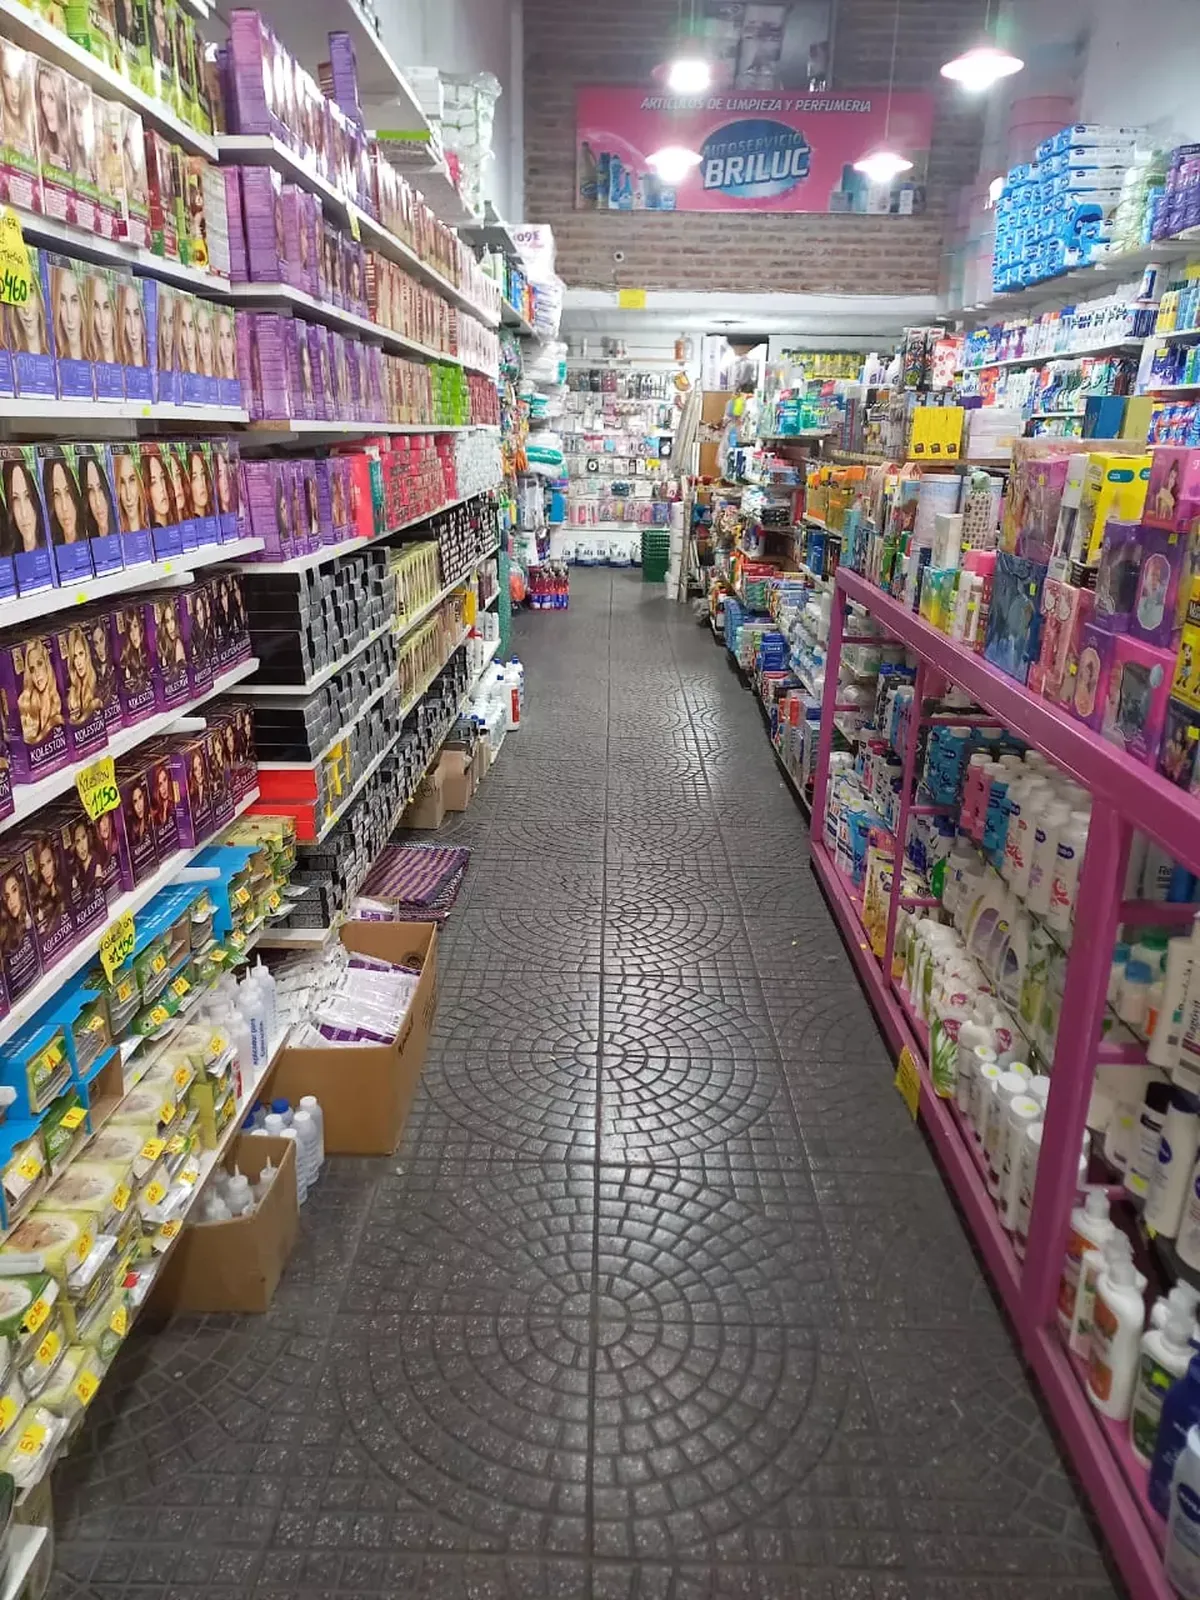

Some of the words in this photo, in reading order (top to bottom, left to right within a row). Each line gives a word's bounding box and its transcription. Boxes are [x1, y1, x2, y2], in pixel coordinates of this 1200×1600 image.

[707, 98, 724, 110] DE
[726, 99, 782, 111] LIMPIEZA
[784, 99, 793, 111] Y
[795, 99, 872, 112] PERFUMERIA
[703, 133, 802, 156] AUTOSERVICIO
[704, 147, 810, 189] BRILUC
[74, 719, 105, 742] KOLESTON
[30, 736, 66, 762] KOLESTON
[43, 922, 73, 953] KOLESTON
